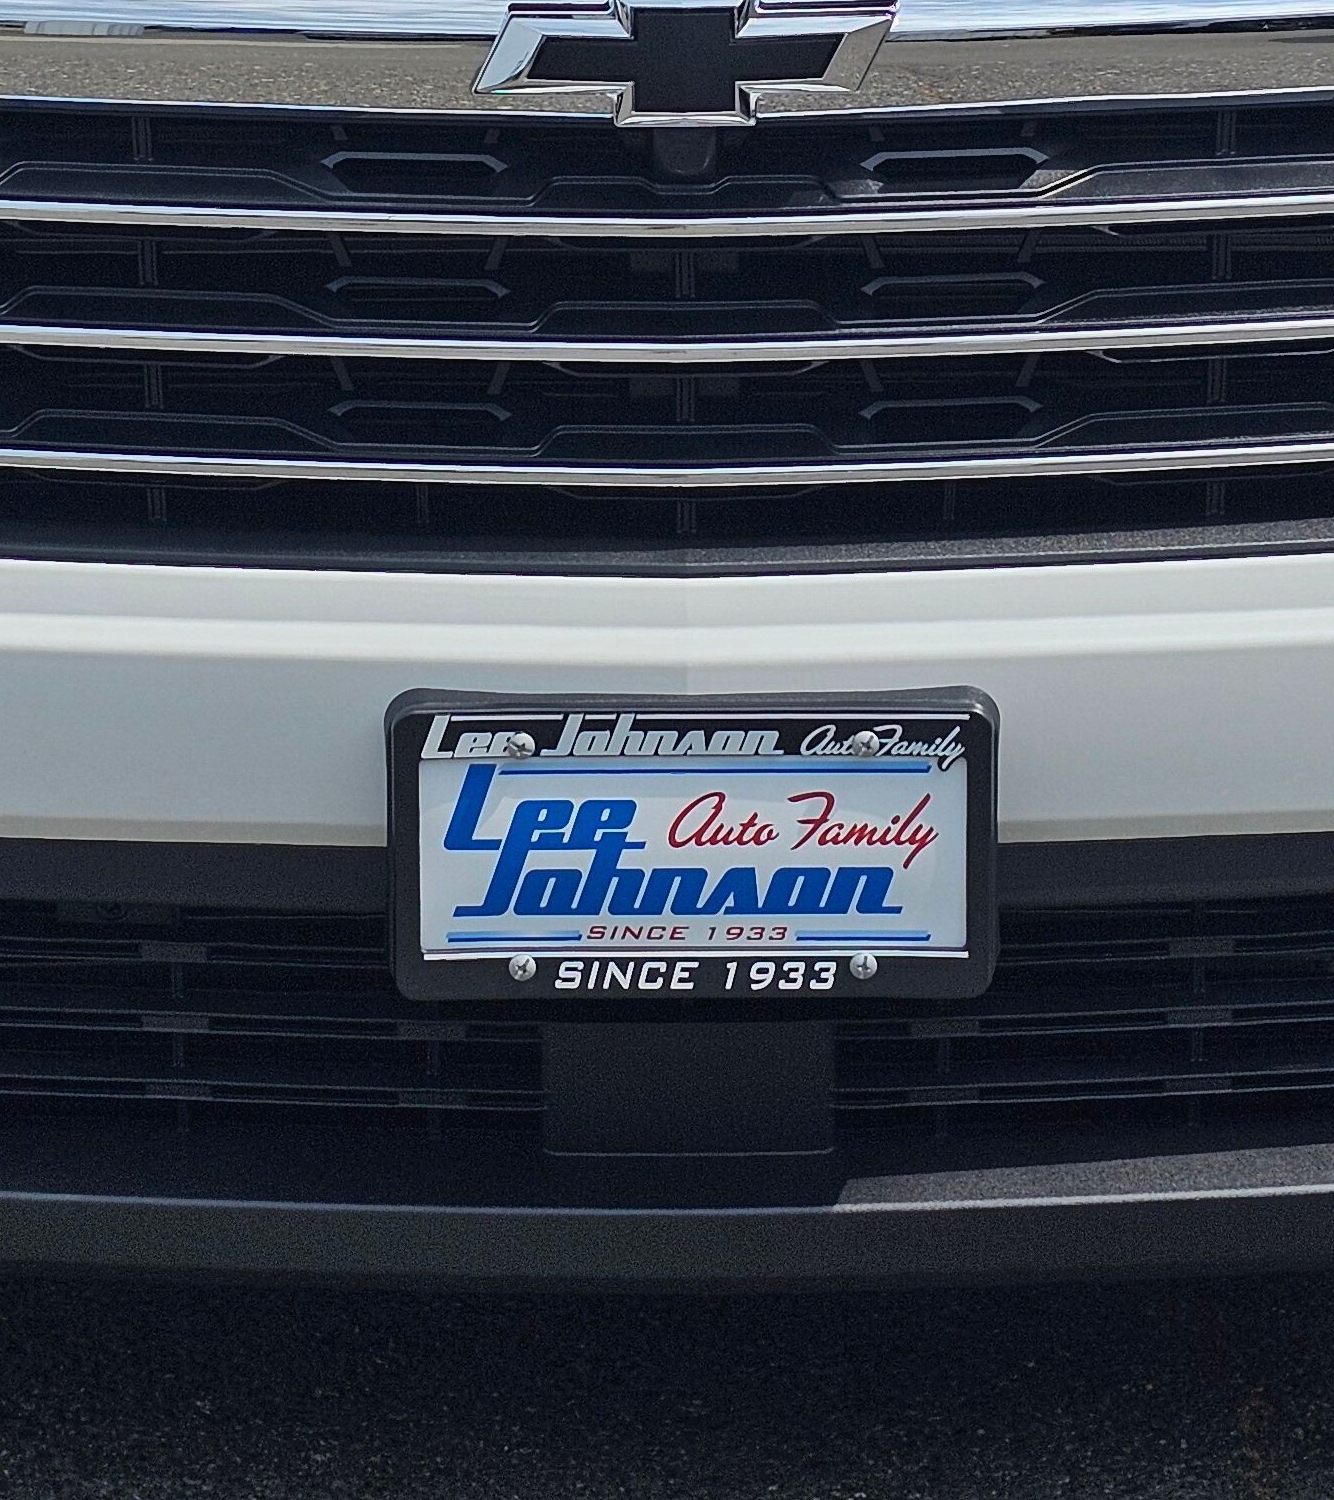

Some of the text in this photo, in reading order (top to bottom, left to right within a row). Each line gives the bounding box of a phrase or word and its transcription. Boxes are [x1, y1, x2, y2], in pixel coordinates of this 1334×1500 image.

[540, 712, 785, 757] Johnson
[799, 724, 857, 756] Aut
[873, 724, 966, 771] Family
[443, 763, 940, 870] Lee Auto Family
[452, 844, 904, 917] Johnson
[586, 925, 789, 941] SINCE 1933
[554, 960, 838, 990] SINCE 1933
